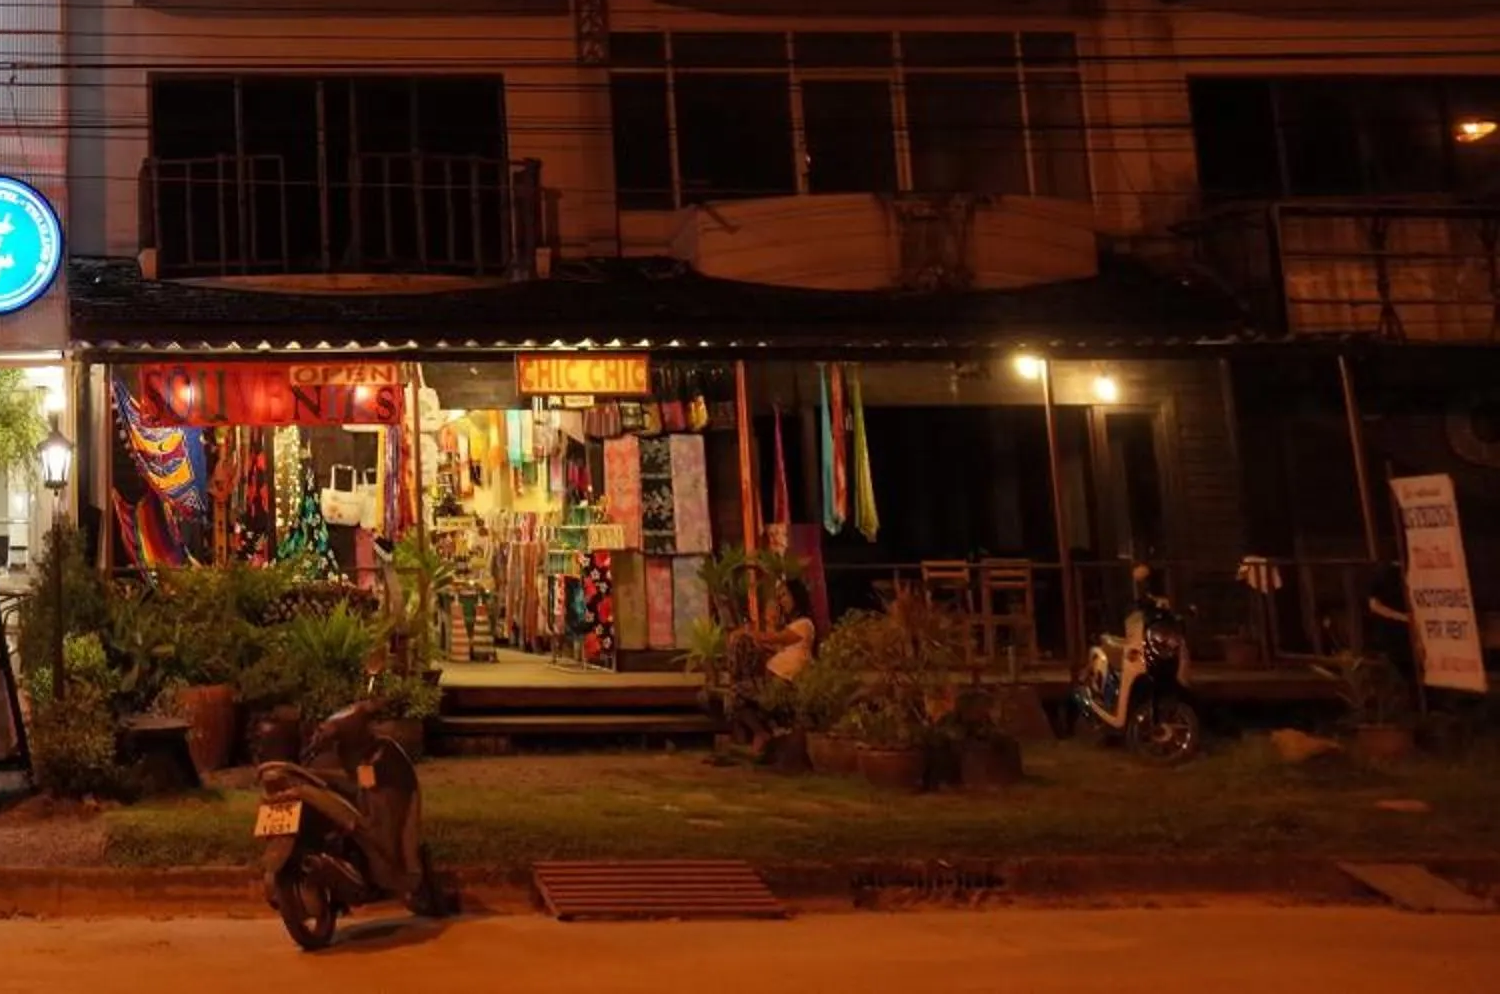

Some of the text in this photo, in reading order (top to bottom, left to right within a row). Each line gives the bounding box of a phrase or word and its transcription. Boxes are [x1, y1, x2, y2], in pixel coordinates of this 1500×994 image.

[294, 366, 392, 383] OPEN
[521, 360, 645, 389] CHIC CHIC
